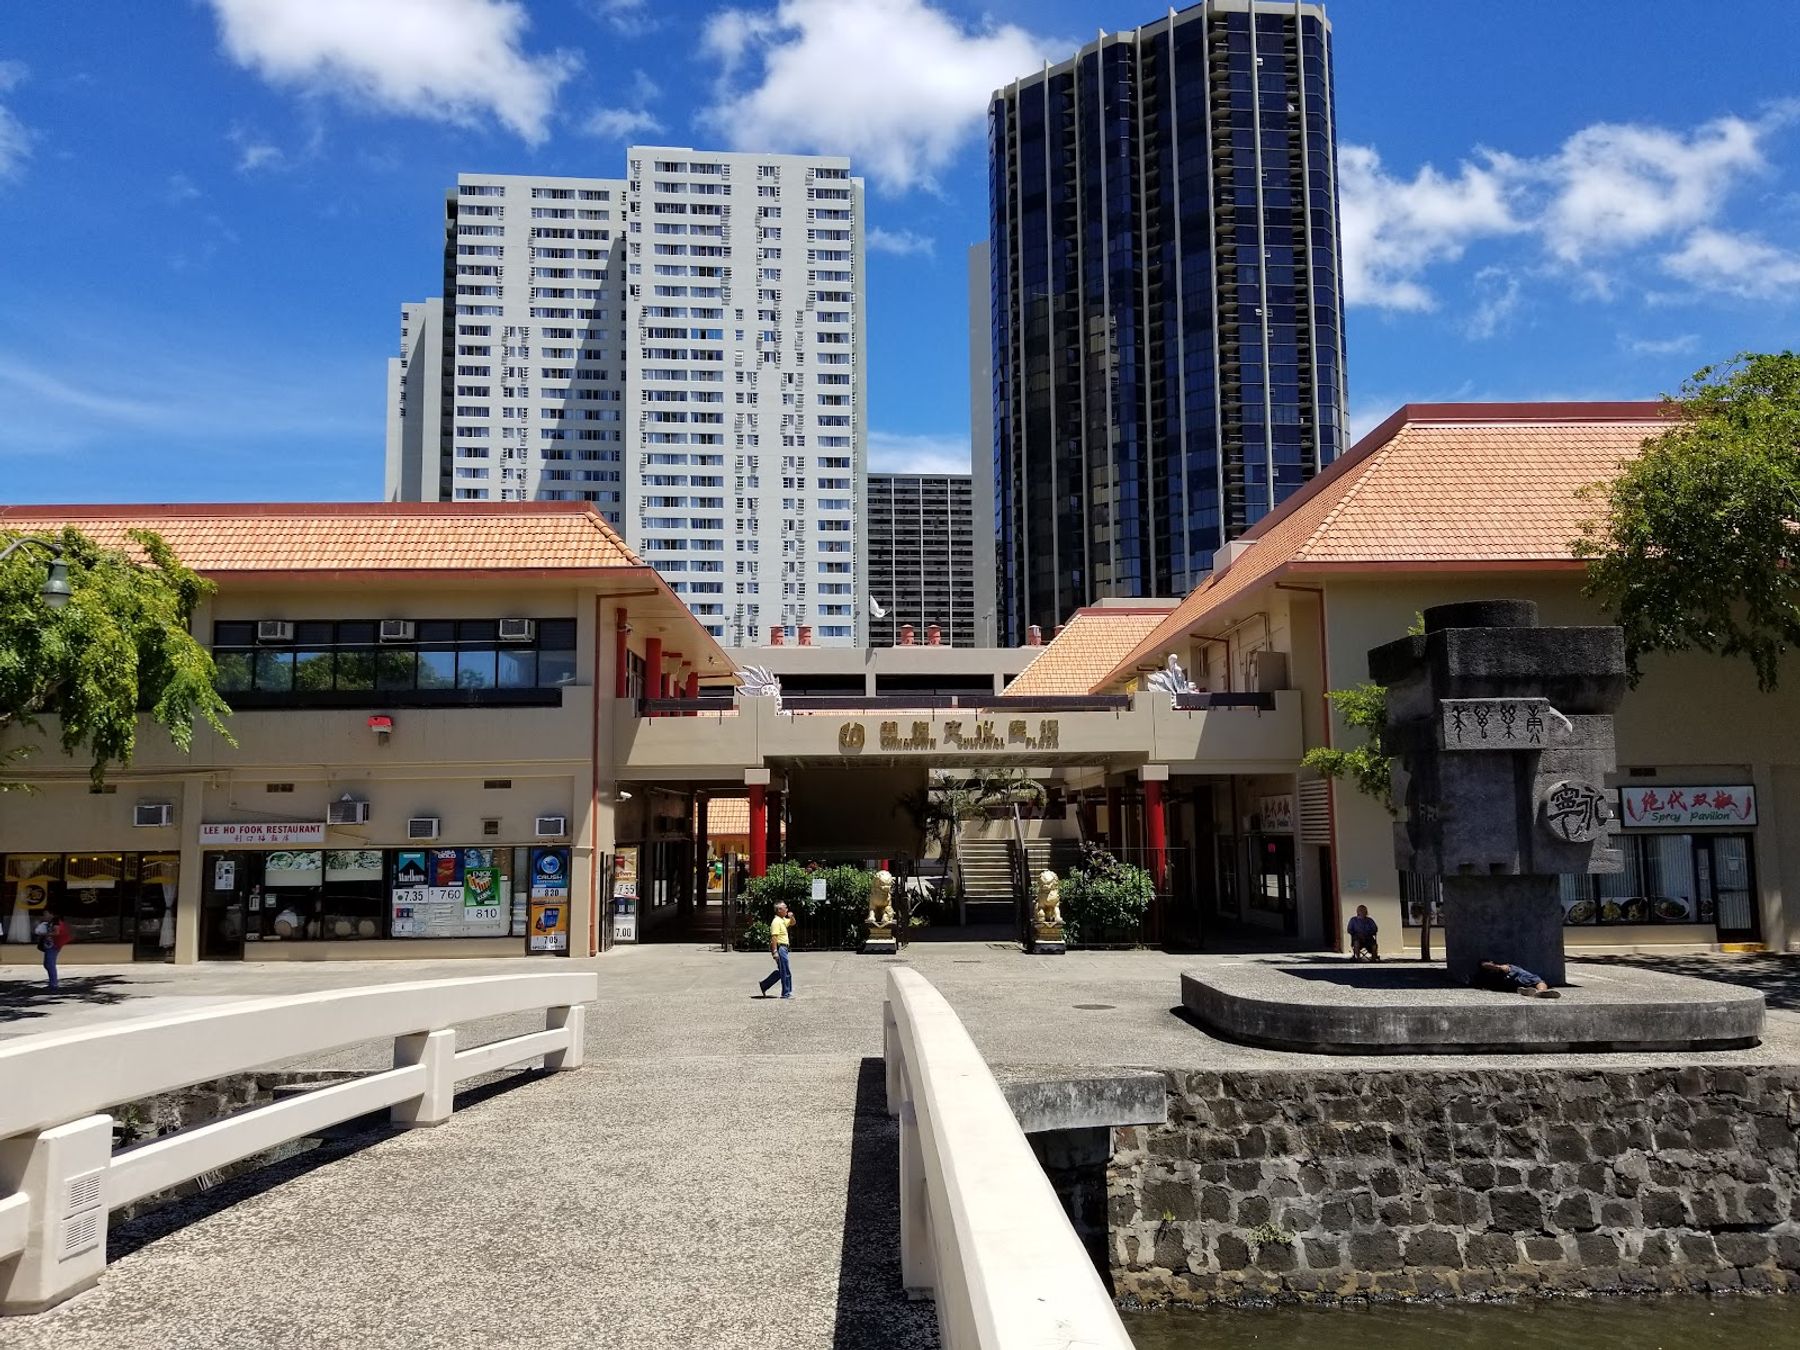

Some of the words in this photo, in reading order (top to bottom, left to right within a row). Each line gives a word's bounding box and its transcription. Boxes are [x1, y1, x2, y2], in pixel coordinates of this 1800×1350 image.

[1689, 811, 1731, 821] Pavilion
[204, 826, 219, 834] LEE
[223, 826, 236, 834] HO
[240, 825, 263, 834] FOOK
[266, 824, 320, 833] RESTAURANT
[404, 891, 423, 902] 7.35
